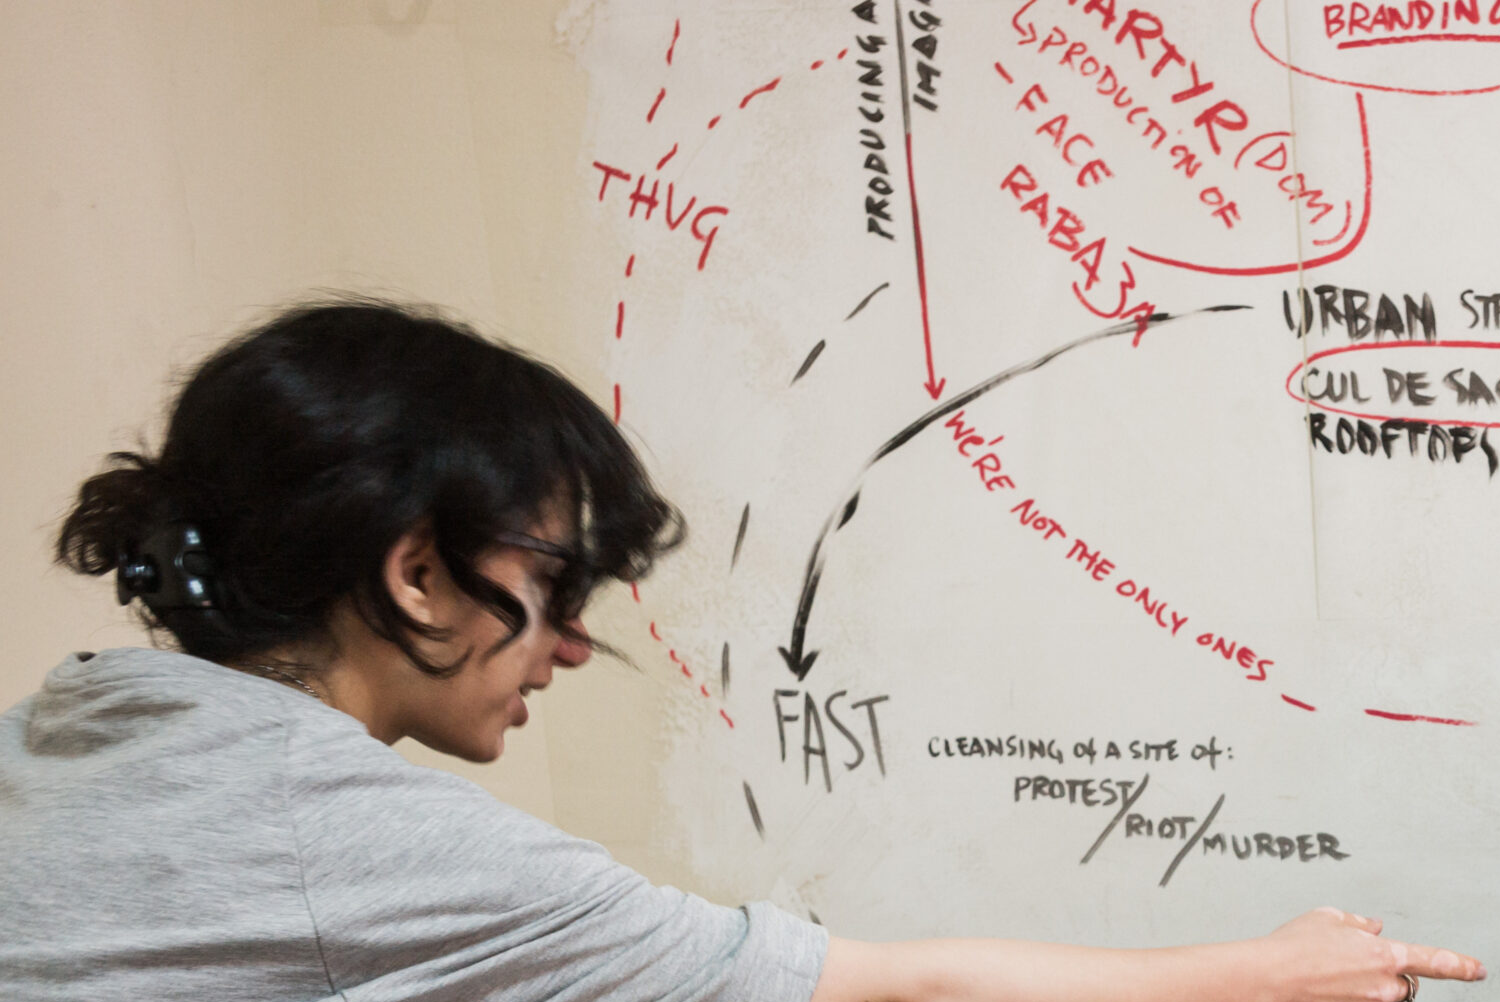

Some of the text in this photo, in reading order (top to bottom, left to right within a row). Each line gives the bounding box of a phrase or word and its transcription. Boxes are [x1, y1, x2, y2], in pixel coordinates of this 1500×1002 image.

[908, 0, 942, 112] IMAG
[856, 34, 895, 241] PRODUCING
[1015, 83, 1115, 188] FACE
[1200, 186, 1243, 229] OF
[1282, 284, 1438, 344] URBAN
[1301, 366, 1372, 402] CUL
[1382, 367, 1437, 405] DE
[1304, 411, 1500, 479] ROOFTOPS
[1010, 498, 1067, 541] NOT
[1065, 538, 1117, 582] THE
[1115, 578, 1189, 638] ONLY
[1196, 632, 1276, 682] ONES
[773, 689, 889, 794] FAST
[927, 735, 1064, 764] CLEANSING
[1104, 740, 1123, 761] A
[1128, 737, 1180, 761] SITE
